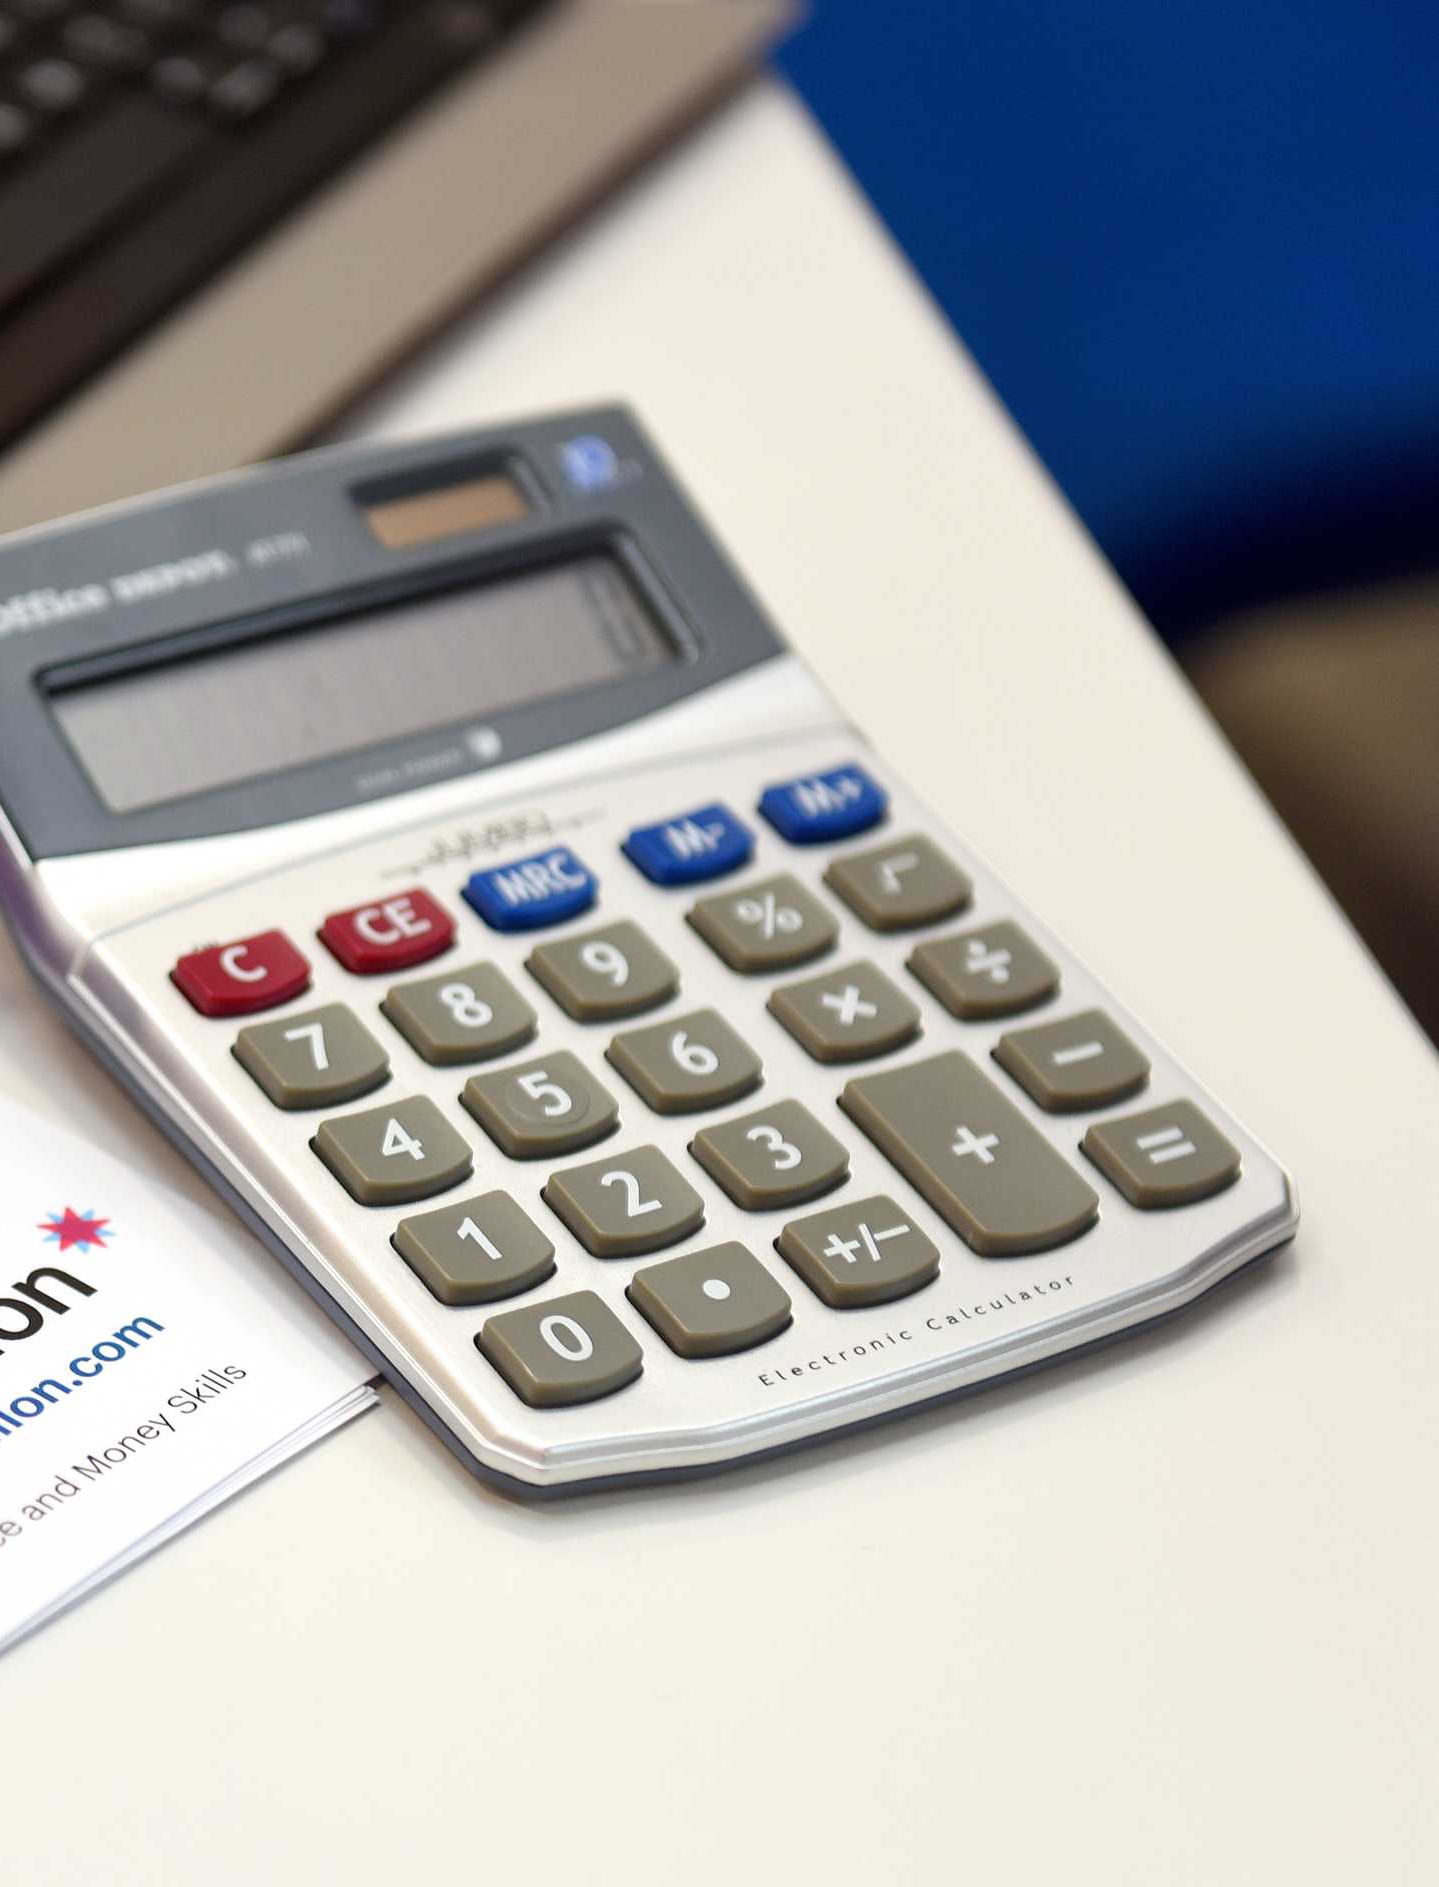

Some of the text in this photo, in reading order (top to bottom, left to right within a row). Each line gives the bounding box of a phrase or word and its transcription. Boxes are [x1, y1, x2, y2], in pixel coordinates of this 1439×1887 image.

[796, 777, 862, 817] M+
[496, 854, 586, 903] MRC
[355, 898, 431, 944] CE
[735, 891, 803, 939] %
[220, 945, 267, 982] C
[582, 943, 629, 985] 9
[440, 983, 493, 1027] 8
[284, 1023, 329, 1070] 7
[671, 1031, 718, 1075] 6
[517, 1071, 572, 1116] 5
[381, 1118, 426, 1161] 4
[746, 1125, 802, 1170] 3
[600, 1170, 663, 1217] 2
[456, 1216, 503, 1260] 1
[539, 1315, 593, 1361] 0
[757, 1274, 1074, 1386] Electronic Calculator
[20, 1474, 82, 1521] and
[72, 1411, 177, 1482] Money
[167, 1363, 248, 1415] Skills
